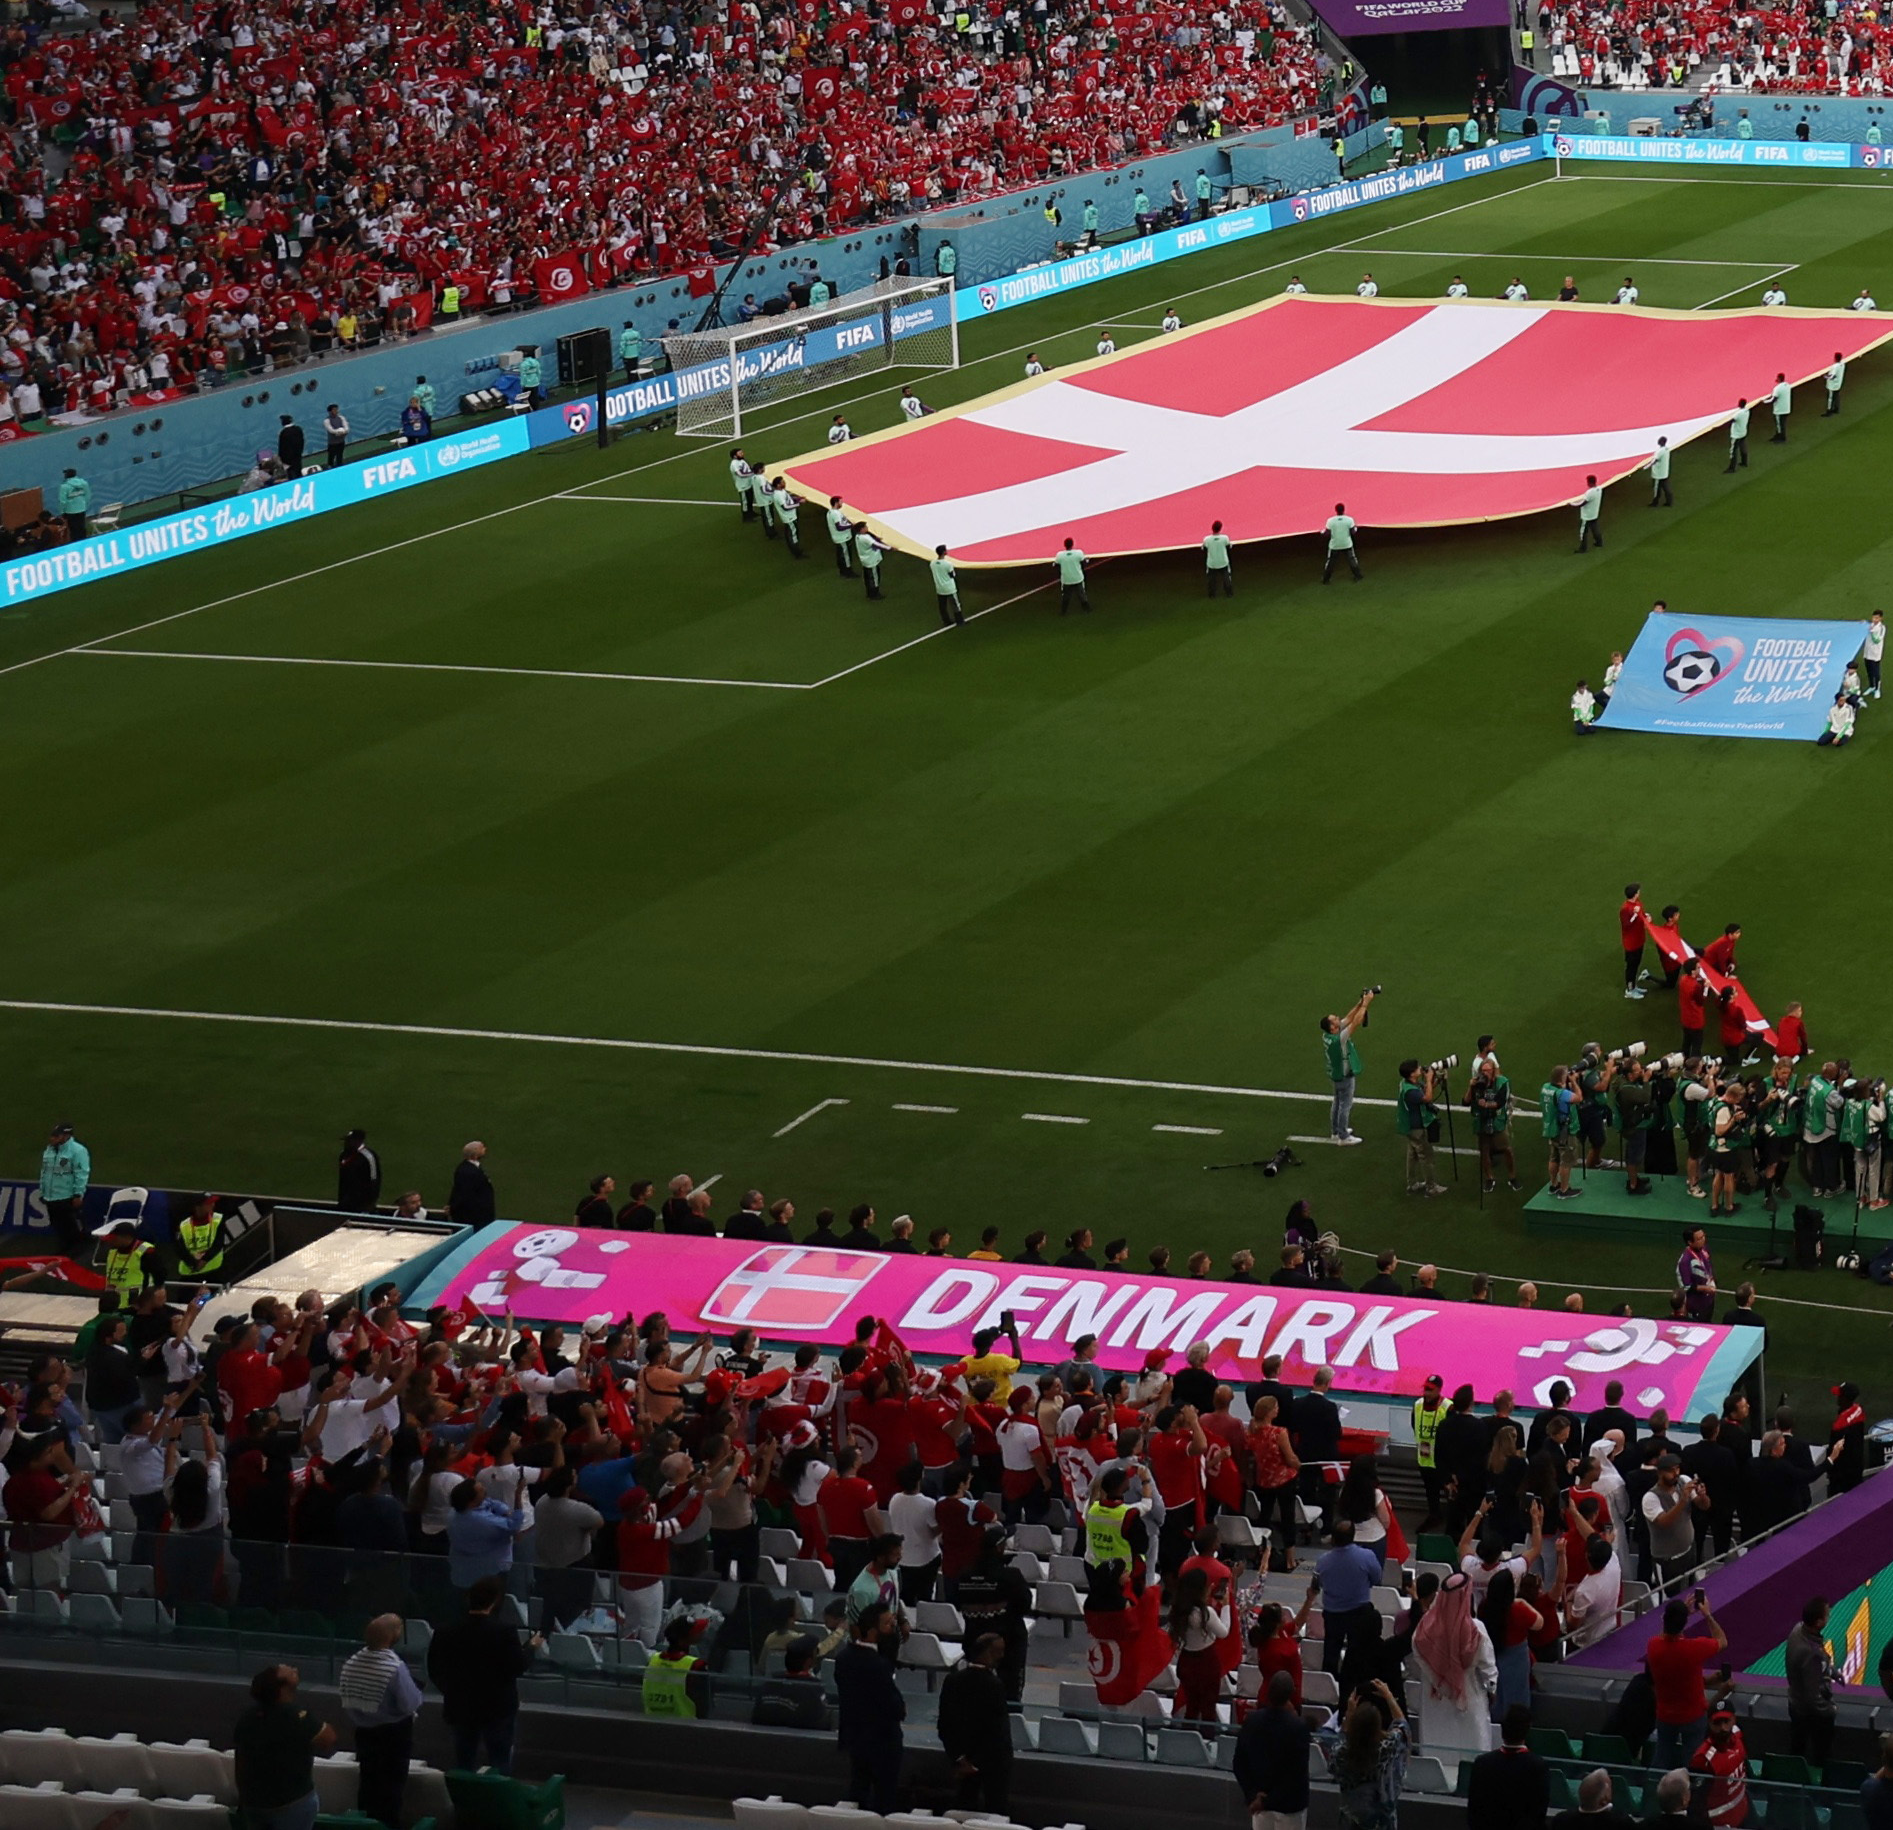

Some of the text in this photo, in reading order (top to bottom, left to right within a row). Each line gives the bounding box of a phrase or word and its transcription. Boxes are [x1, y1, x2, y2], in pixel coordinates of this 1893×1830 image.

[1356, 4, 1386, 12] FIFA
[1387, 0, 1439, 10] WORLD
[1464, 152, 1490, 173] FIFA
[1311, 163, 1444, 213] FOOTBALL UNITES the World
[836, 324, 874, 350] FIFA
[678, 364, 730, 399] UNITES
[736, 354, 758, 381] the
[761, 340, 803, 376] World
[363, 456, 416, 490] FIFA
[6, 481, 314, 596] FOOTBALL UNITES the World
[1753, 638, 1832, 658] FOOTBALL
[1743, 658, 1828, 682] UNITES
[1733, 680, 1820, 705] the World
[898, 1268, 1440, 1372] DENMARK
